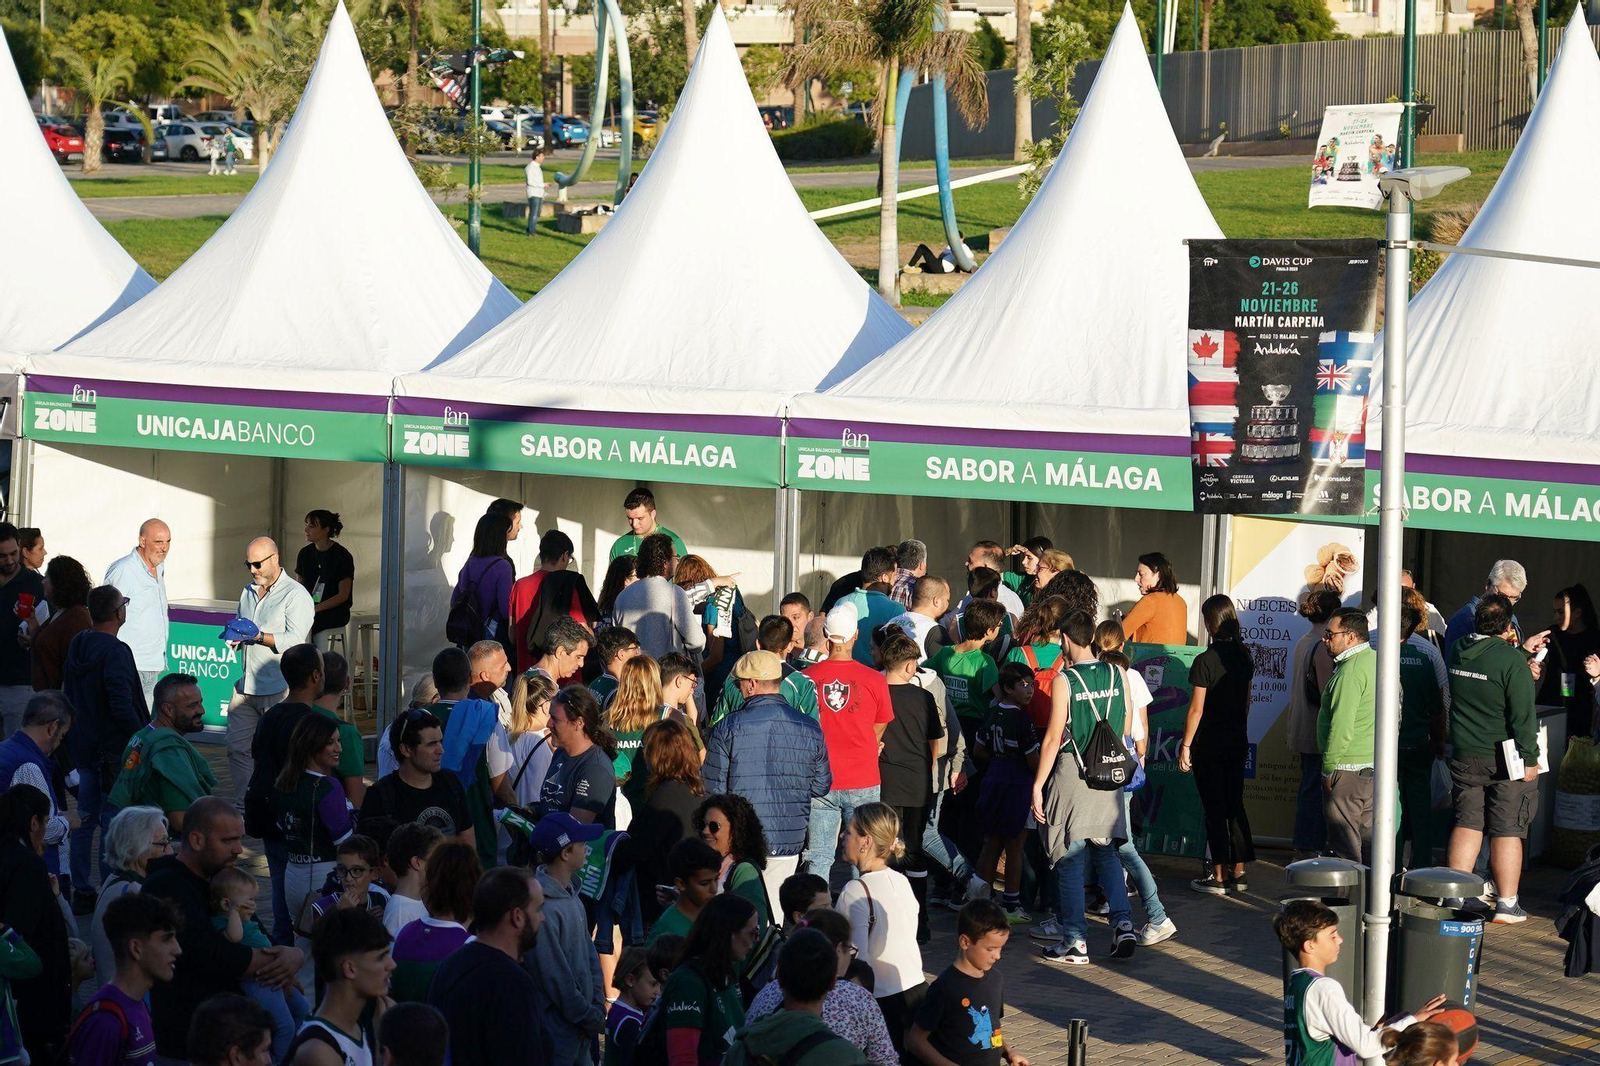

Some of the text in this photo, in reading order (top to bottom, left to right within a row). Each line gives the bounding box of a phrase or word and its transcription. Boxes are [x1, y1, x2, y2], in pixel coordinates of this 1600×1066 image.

[1262, 257, 1313, 266] DAVIS CUP
[1261, 281, 1299, 295] 21-26
[1240, 298, 1318, 313] NOVIEMBRE
[1234, 313, 1325, 328] MARTÍN CARPENA
[1253, 342, 1301, 356] Andalucía
[72, 383, 96, 404] fan
[34, 408, 96, 434] ZONE
[443, 406, 470, 426] fan
[404, 432, 470, 458] ZONE
[841, 427, 870, 449] fan
[520, 433, 738, 469] SABOR A MÁLAGA
[797, 454, 870, 482] ZONE
[925, 456, 1164, 492] SABOR A MÁLAGA
[1478, 490, 1496, 516] A
[1236, 598, 1298, 614] NUECES
[1257, 613, 1274, 626] de
[1239, 627, 1292, 641] RONDA
[171, 644, 238, 664] UNICAJA
[179, 660, 230, 679] BANCO
[1259, 682, 1288, 692] 10.000
